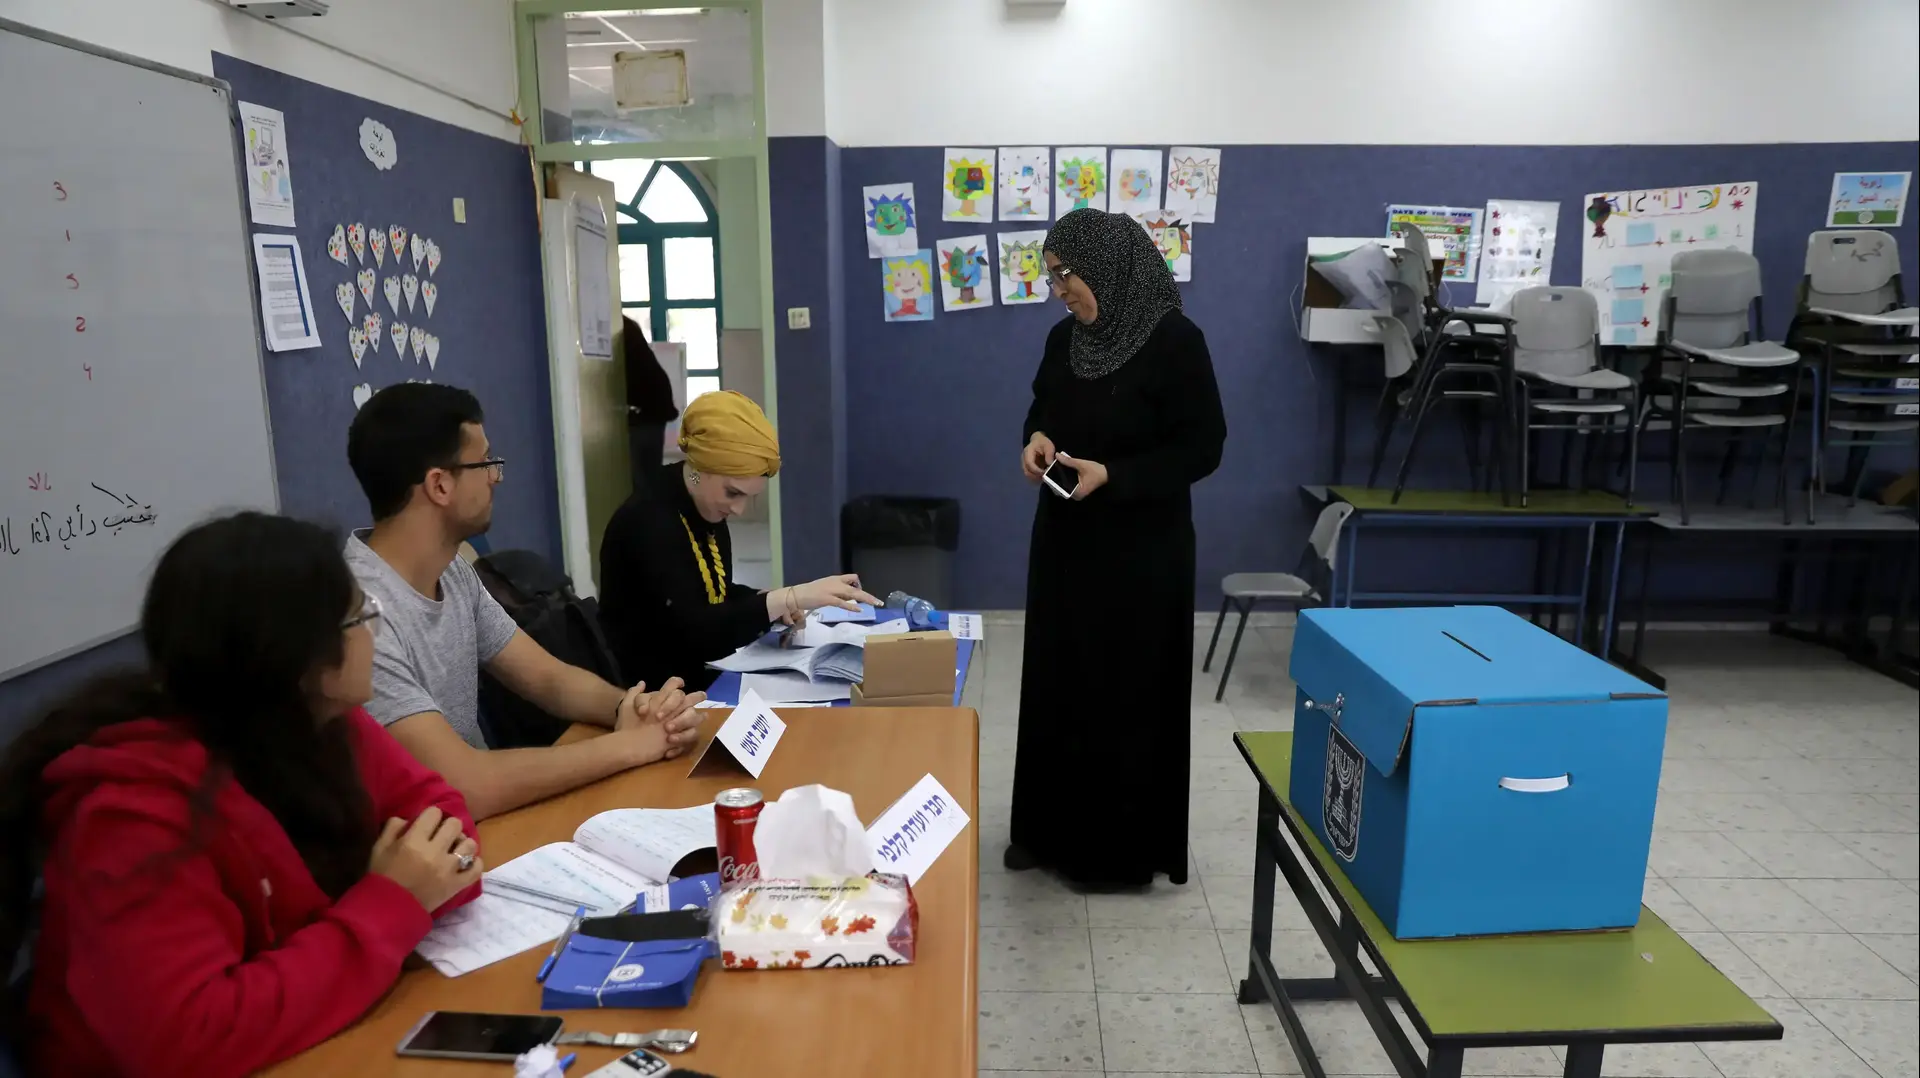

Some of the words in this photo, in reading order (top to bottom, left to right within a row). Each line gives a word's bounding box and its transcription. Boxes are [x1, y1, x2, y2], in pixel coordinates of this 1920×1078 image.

[53, 181, 67, 201] 3
[76, 316, 86, 333] 2
[83, 362, 92, 381] 4
[740, 731, 761, 757] ראש
[922, 794, 948, 817] חבר
[900, 809, 931, 843] ועדת
[877, 832, 911, 863] קלפי
[720, 856, 760, 882] Coca
